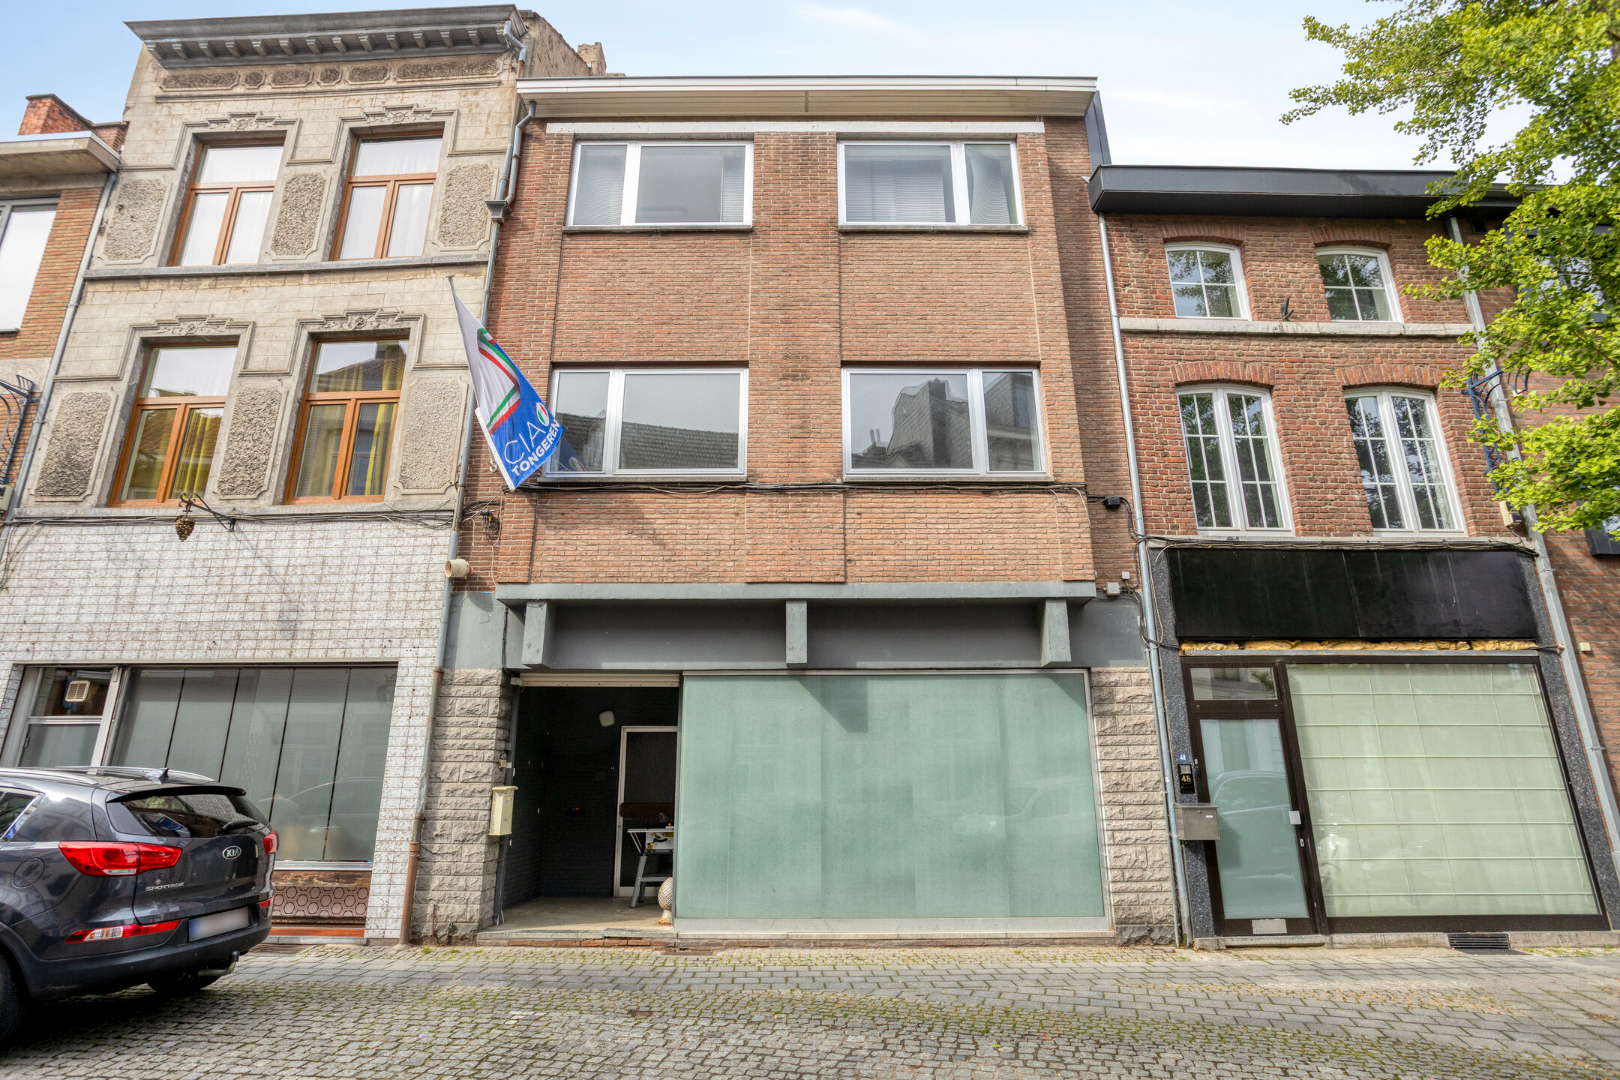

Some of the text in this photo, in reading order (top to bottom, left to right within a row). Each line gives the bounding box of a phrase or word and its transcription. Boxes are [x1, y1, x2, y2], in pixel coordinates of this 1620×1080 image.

[511, 419, 561, 476] TONGEREN
[1181, 775, 1192, 783] 48
[225, 847, 240, 858] KIA
[145, 882, 184, 891] SPORTAGE
